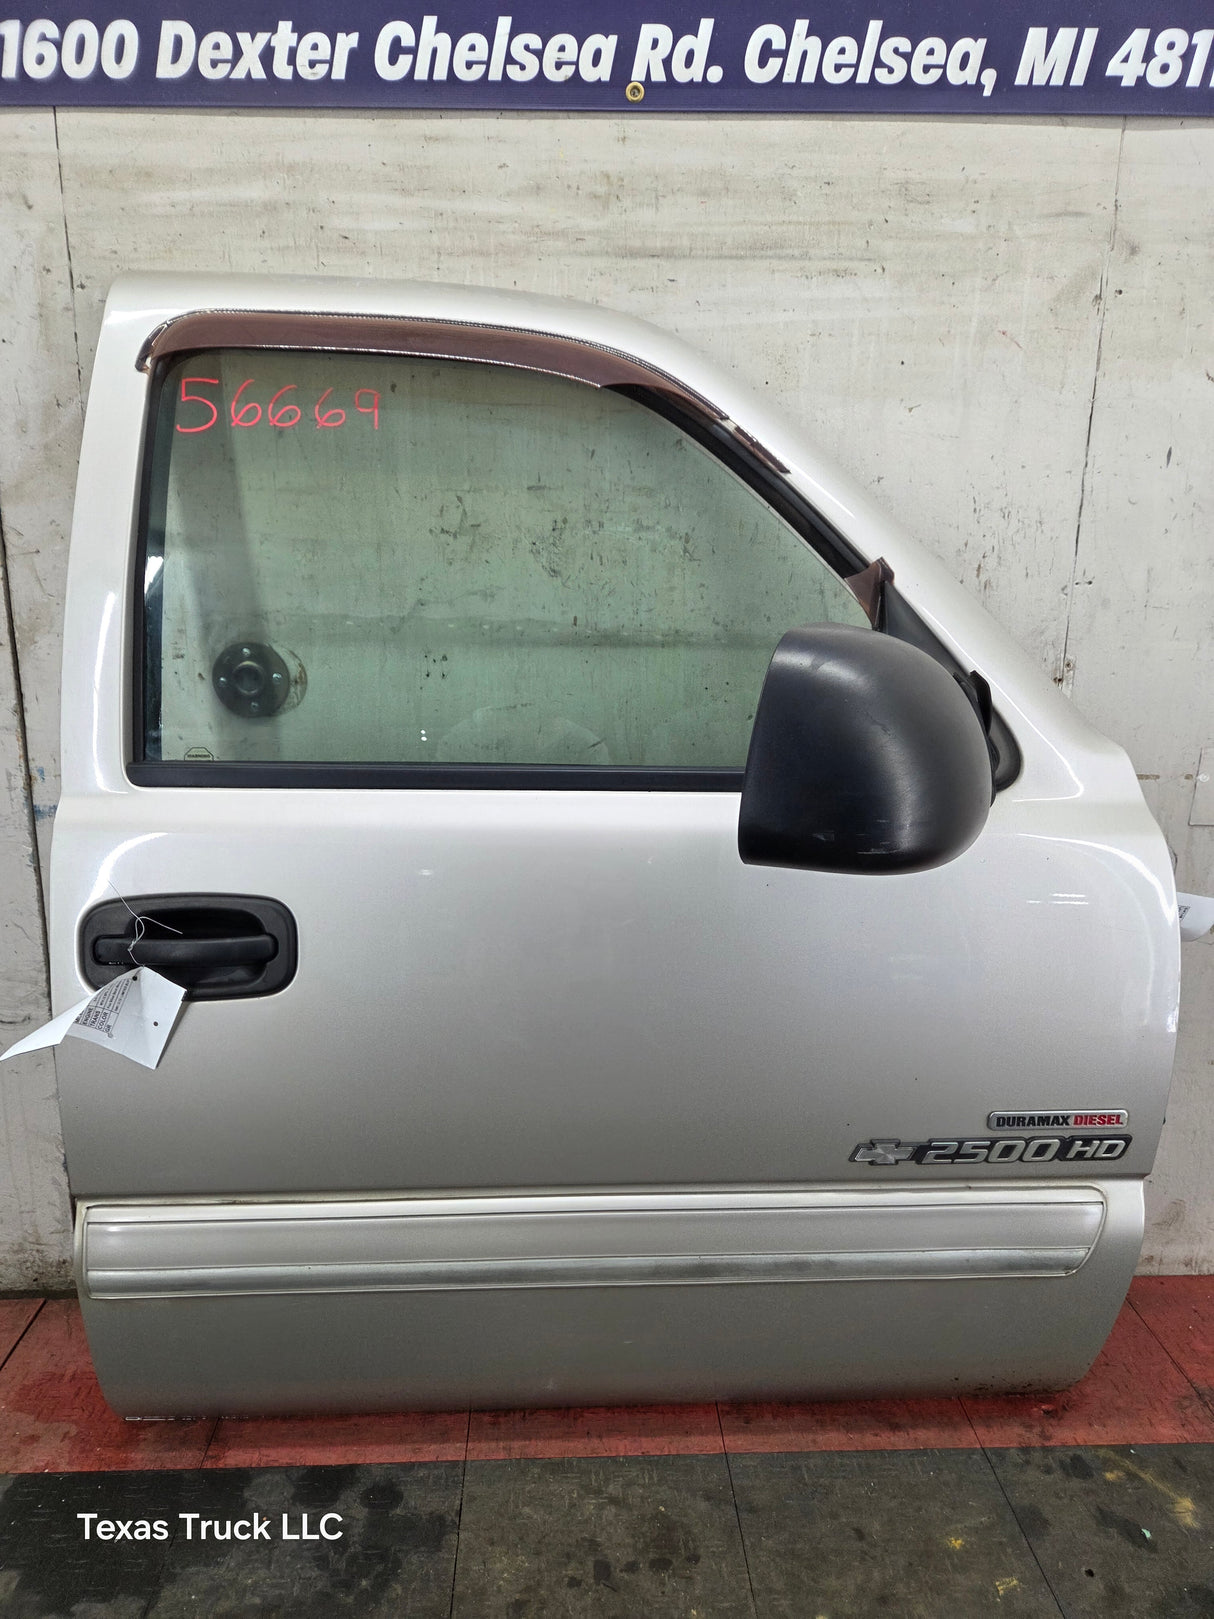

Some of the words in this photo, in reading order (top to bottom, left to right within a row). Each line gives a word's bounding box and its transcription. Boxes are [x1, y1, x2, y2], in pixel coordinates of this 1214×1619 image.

[0, 18, 138, 80] 1600
[155, 19, 359, 80] Dexter
[373, 15, 617, 81] Chelsea
[632, 18, 724, 83] Rd.
[744, 19, 997, 96] Chelsea,
[1014, 27, 1099, 87] MI
[1105, 27, 1214, 88] 481
[176, 377, 380, 432] 56669
[83, 1008, 94, 1025] ENGINE
[90, 1010, 101, 1026] TRANS
[98, 1011, 109, 1030] COLOR
[995, 1115, 1070, 1128] DURAMAX
[1073, 1114, 1124, 1126] DIESEL
[921, 1139, 1061, 1163] 2500
[1066, 1140, 1126, 1160] HD
